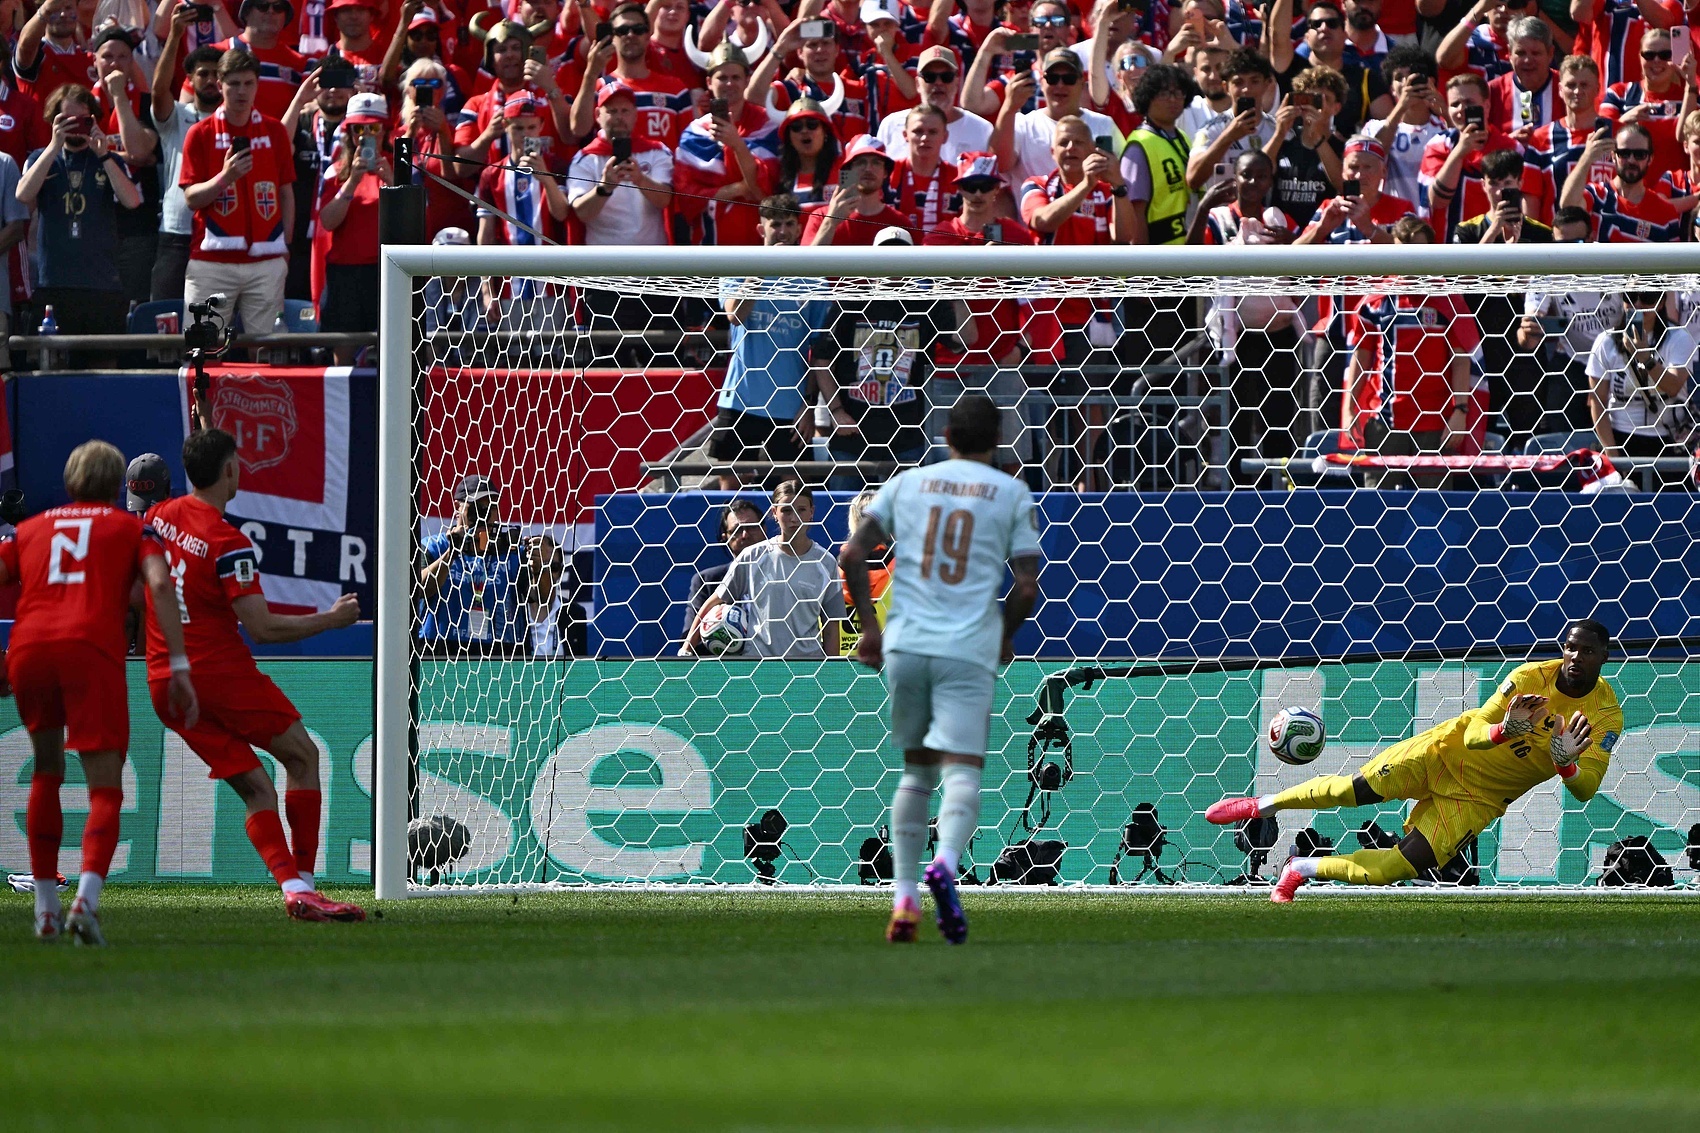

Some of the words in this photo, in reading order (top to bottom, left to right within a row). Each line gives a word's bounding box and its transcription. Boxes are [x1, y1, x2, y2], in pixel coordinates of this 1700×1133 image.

[647, 112, 671, 137] 20
[1278, 177, 1326, 192] mirates
[62, 192, 86, 215] 10
[878, 320, 898, 328] FIFA
[48, 518, 93, 585] 2
[921, 505, 976, 586] 19
[1509, 739, 1532, 759] 16
